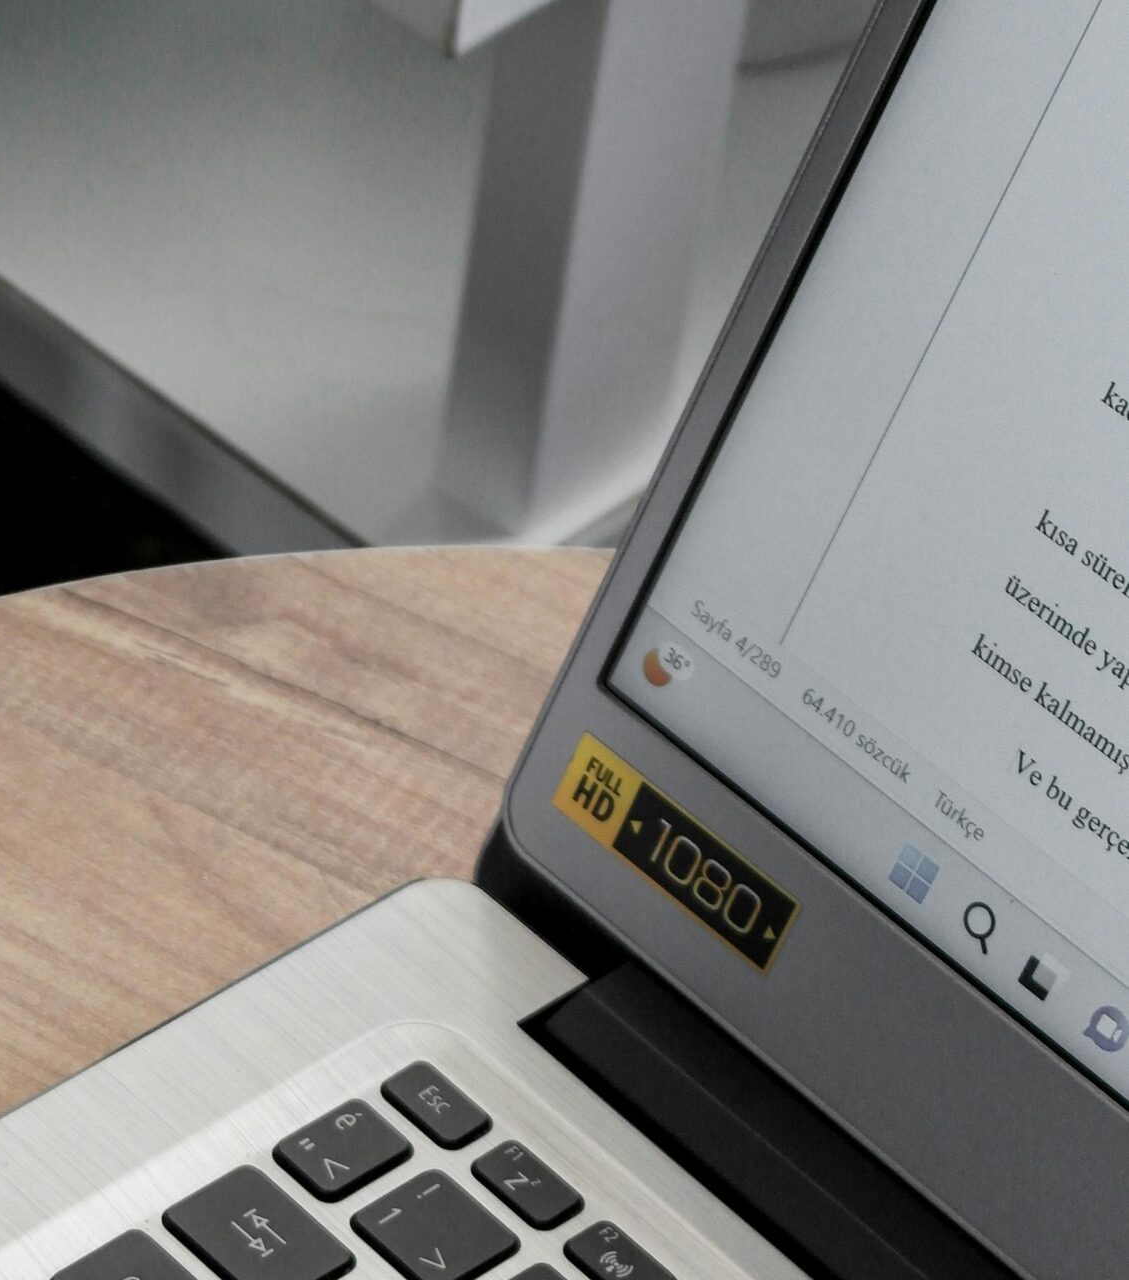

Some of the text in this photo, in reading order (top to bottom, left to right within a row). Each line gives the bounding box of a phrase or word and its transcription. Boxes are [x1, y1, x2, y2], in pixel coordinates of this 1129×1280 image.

[1100, 381, 1129, 421] ka
[1035, 509, 1079, 556] kısa
[690, 599, 782, 679] Sayfa 4/289
[1004, 575, 1097, 655] üzerimde
[663, 647, 691, 671] 36°
[971, 635, 1032, 692] kimse
[802, 688, 912, 785] 64.410 sözcük
[572, 774, 615, 822] HD
[586, 756, 624, 797] FULL
[933, 789, 985, 841] Türkçe
[1017, 749, 1129, 860] Ve bu gerçe
[650, 817, 763, 935] 1080
[504, 1145, 524, 1161] F1
[378, 1207, 402, 1225] 1
[599, 1226, 619, 1243] F2
